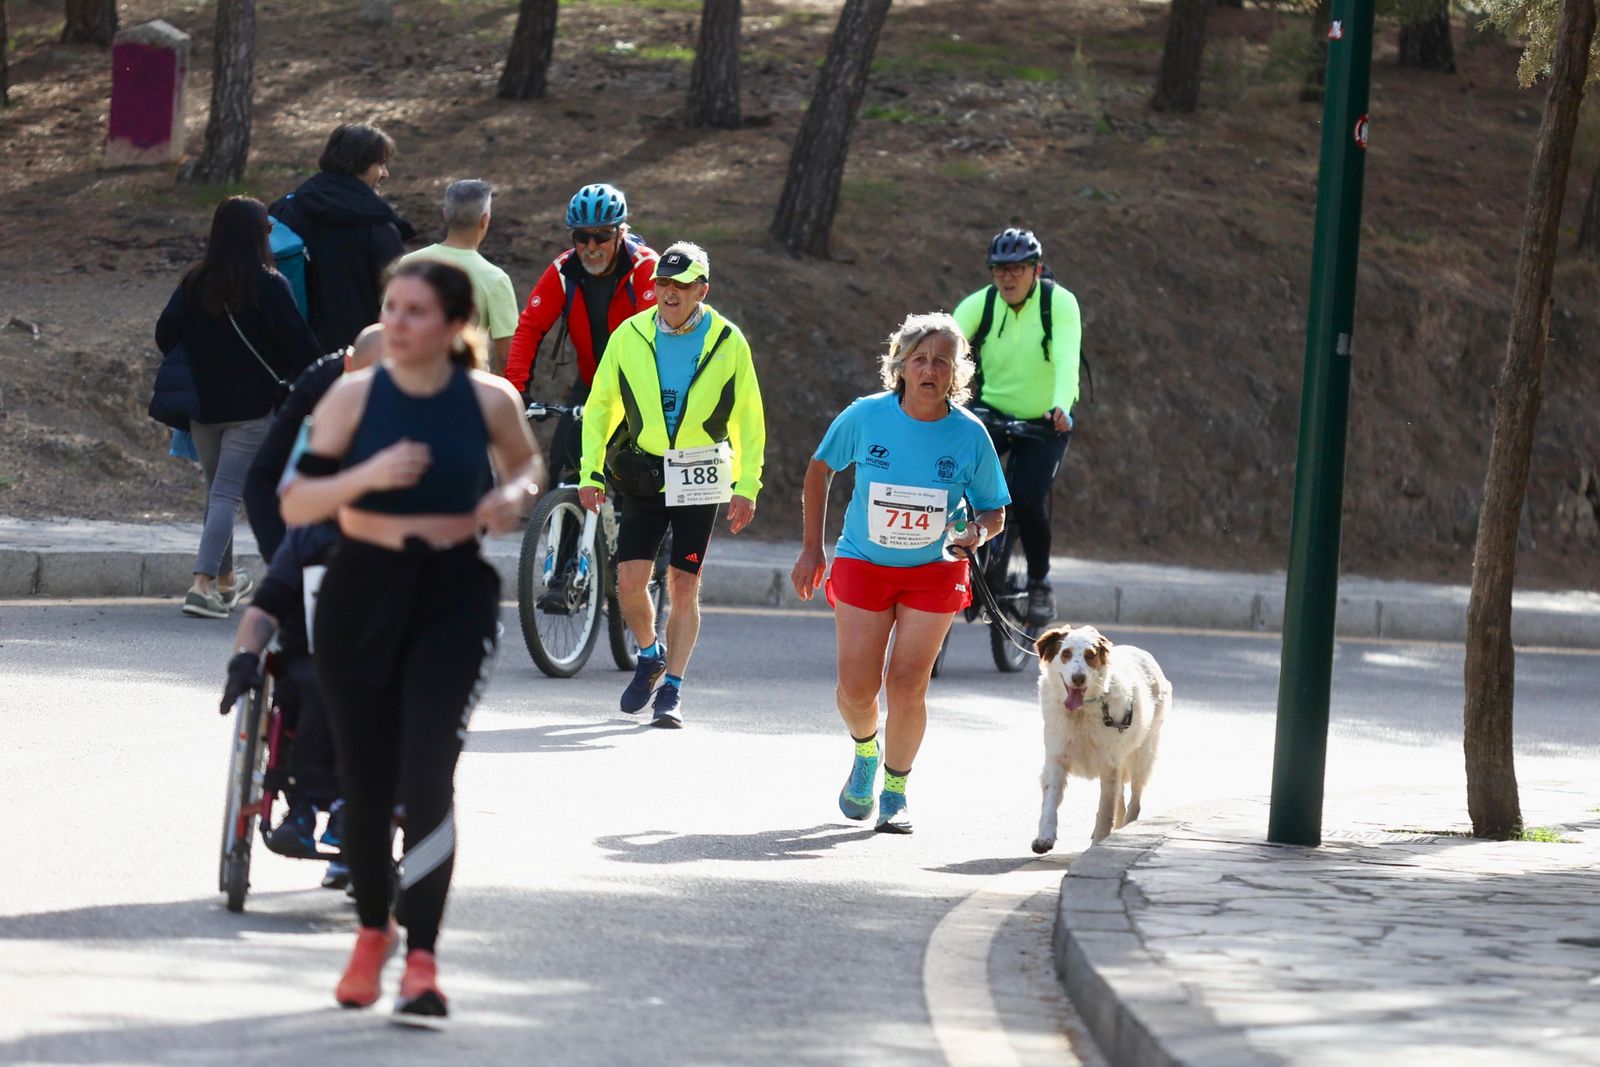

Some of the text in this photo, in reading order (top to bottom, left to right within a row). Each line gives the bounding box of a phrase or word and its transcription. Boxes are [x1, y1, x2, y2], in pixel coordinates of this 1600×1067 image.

[865, 457, 890, 467] HYUNDAI
[680, 466, 719, 485] 188
[886, 509, 930, 530] 714
